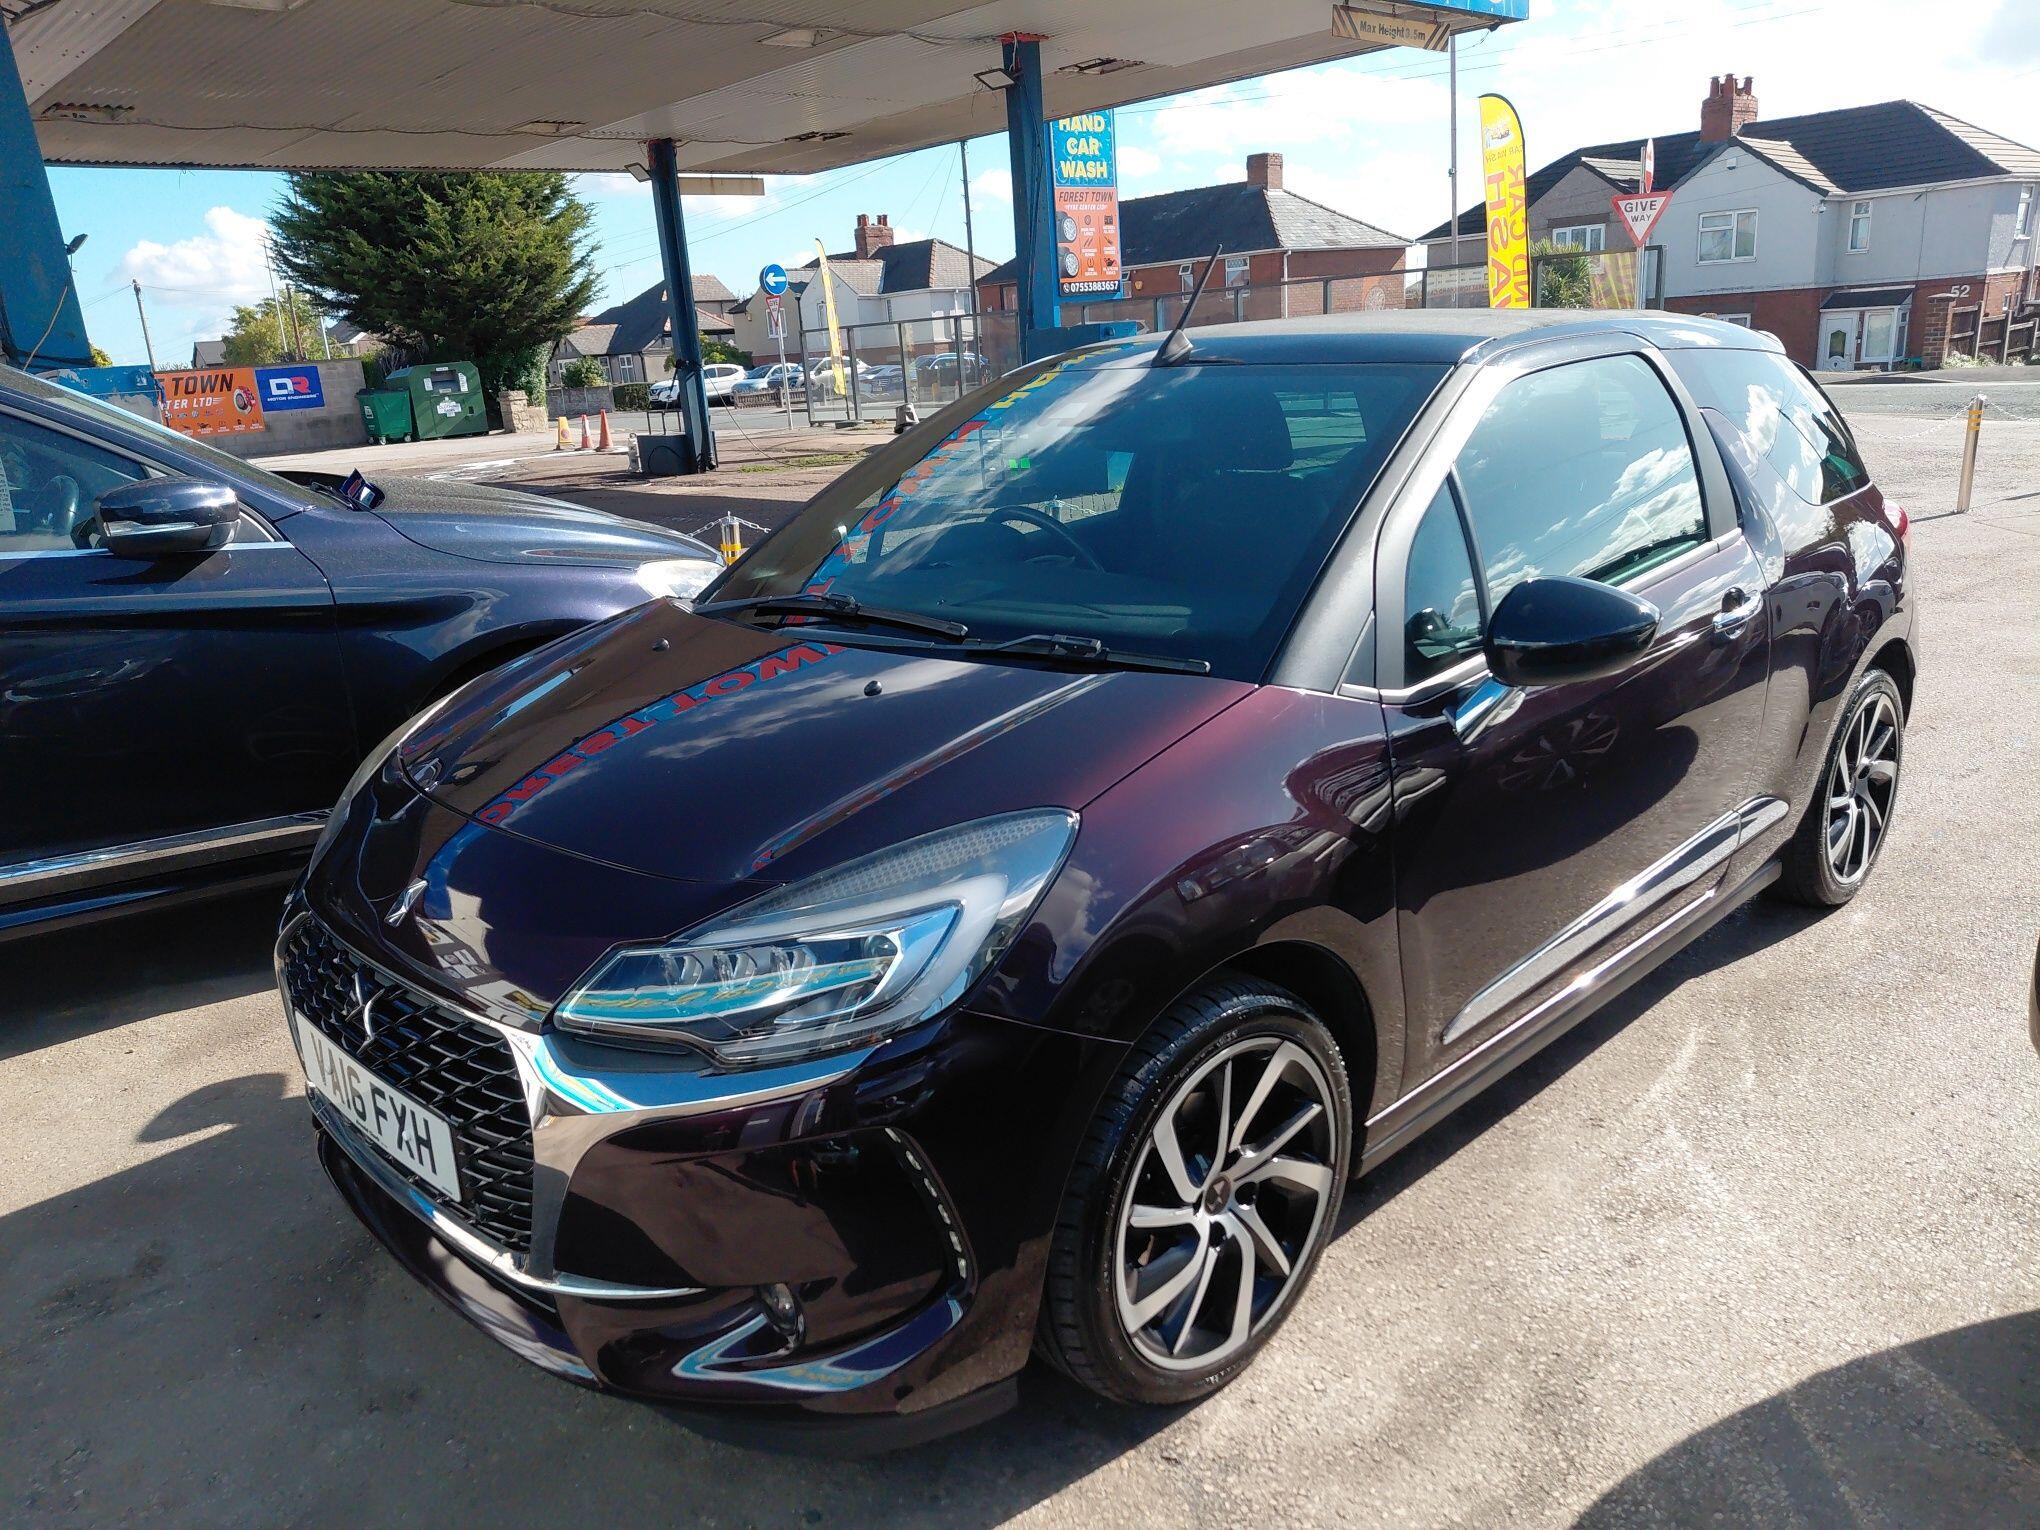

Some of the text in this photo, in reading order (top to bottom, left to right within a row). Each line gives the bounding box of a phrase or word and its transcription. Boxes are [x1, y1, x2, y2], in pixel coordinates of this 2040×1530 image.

[1360, 21, 1426, 41] Max Height 3.5m
[1059, 114, 1105, 132] HAND
[1066, 137, 1099, 155] CAR
[1060, 161, 1108, 178] WASH
[1059, 191, 1114, 202] FOREST TOWN
[1624, 200, 1657, 212] GIVE
[1631, 214, 1652, 222] WAY
[1950, 284, 1971, 298] 52
[172, 373, 234, 396] TOWN
[192, 397, 213, 408] LTD
[310, 1031, 438, 1176] VA16 FXH
